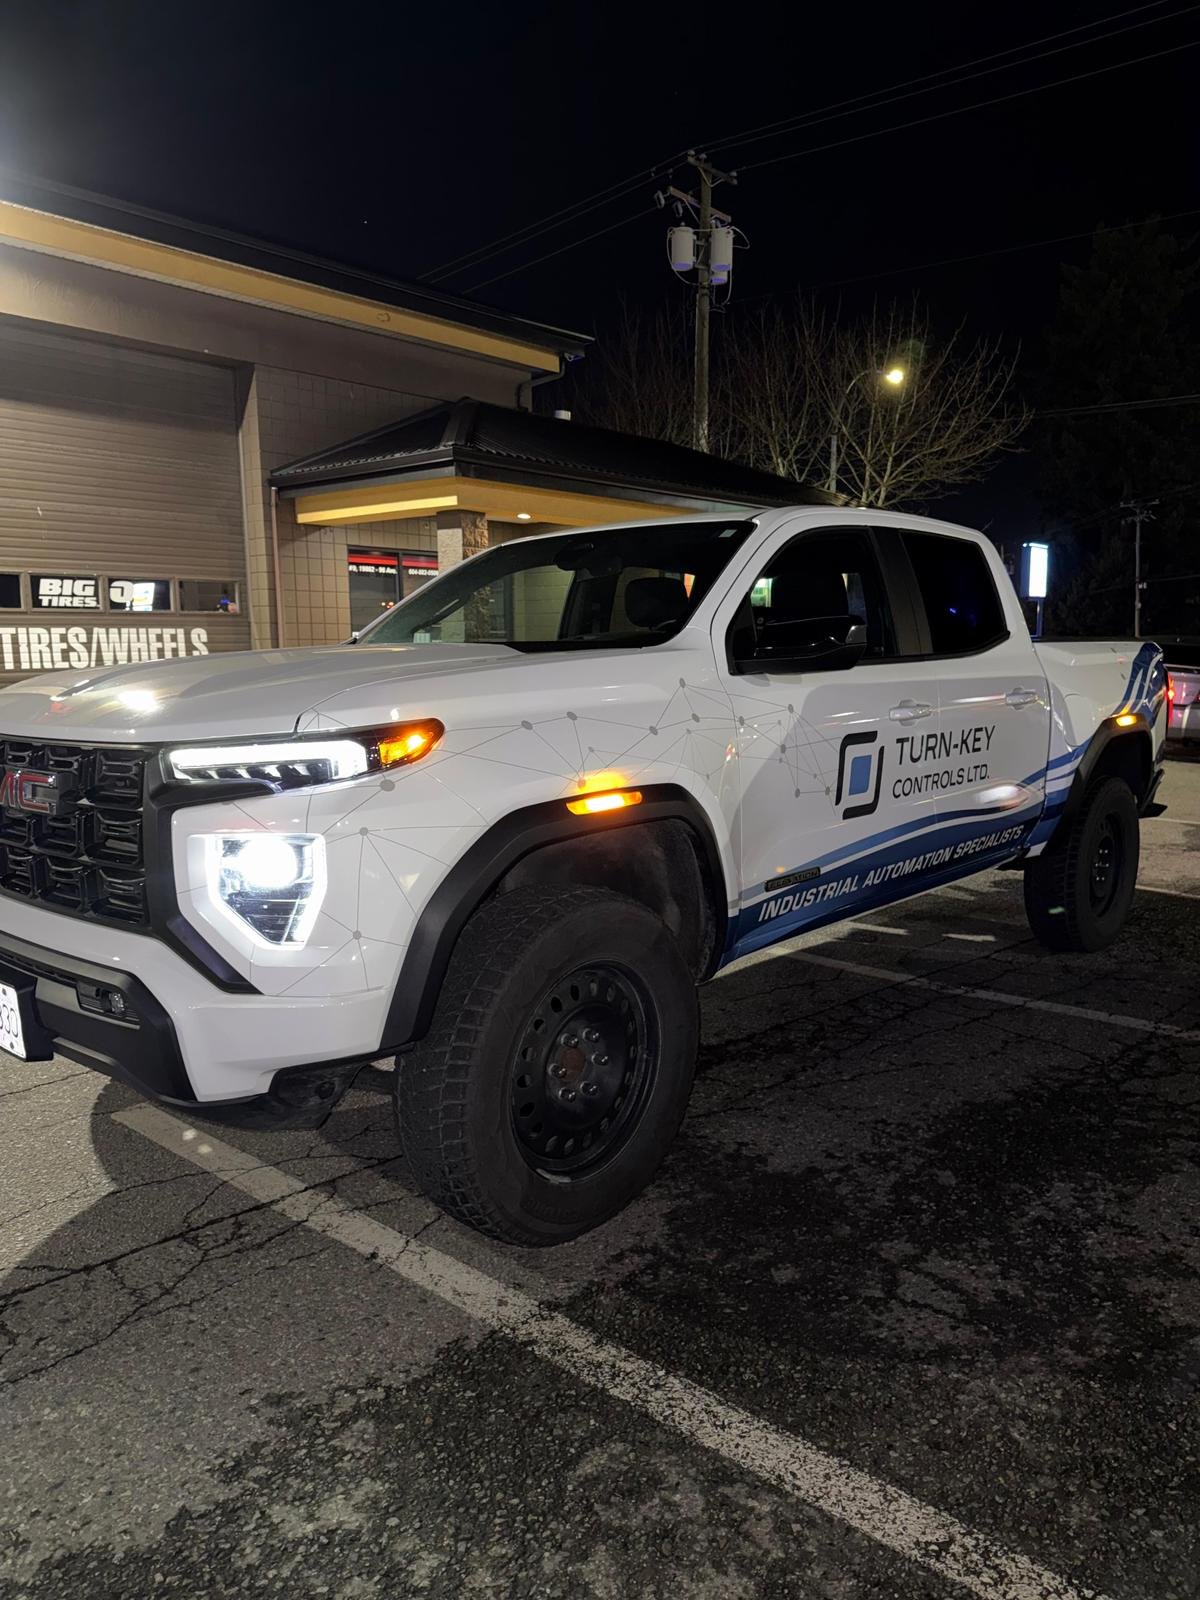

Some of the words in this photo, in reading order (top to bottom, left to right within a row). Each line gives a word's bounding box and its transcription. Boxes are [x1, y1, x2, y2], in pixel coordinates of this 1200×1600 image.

[38, 578, 96, 597] BIG
[38, 595, 98, 608] TIRES
[895, 725, 996, 766] TURN-KEY
[892, 767, 965, 799] CONTROLS
[966, 764, 990, 784] LTD.
[758, 874, 858, 922] INDUSTRIAL
[862, 844, 954, 889] AUTOMATION
[952, 824, 1025, 859] SPECIALISTS
